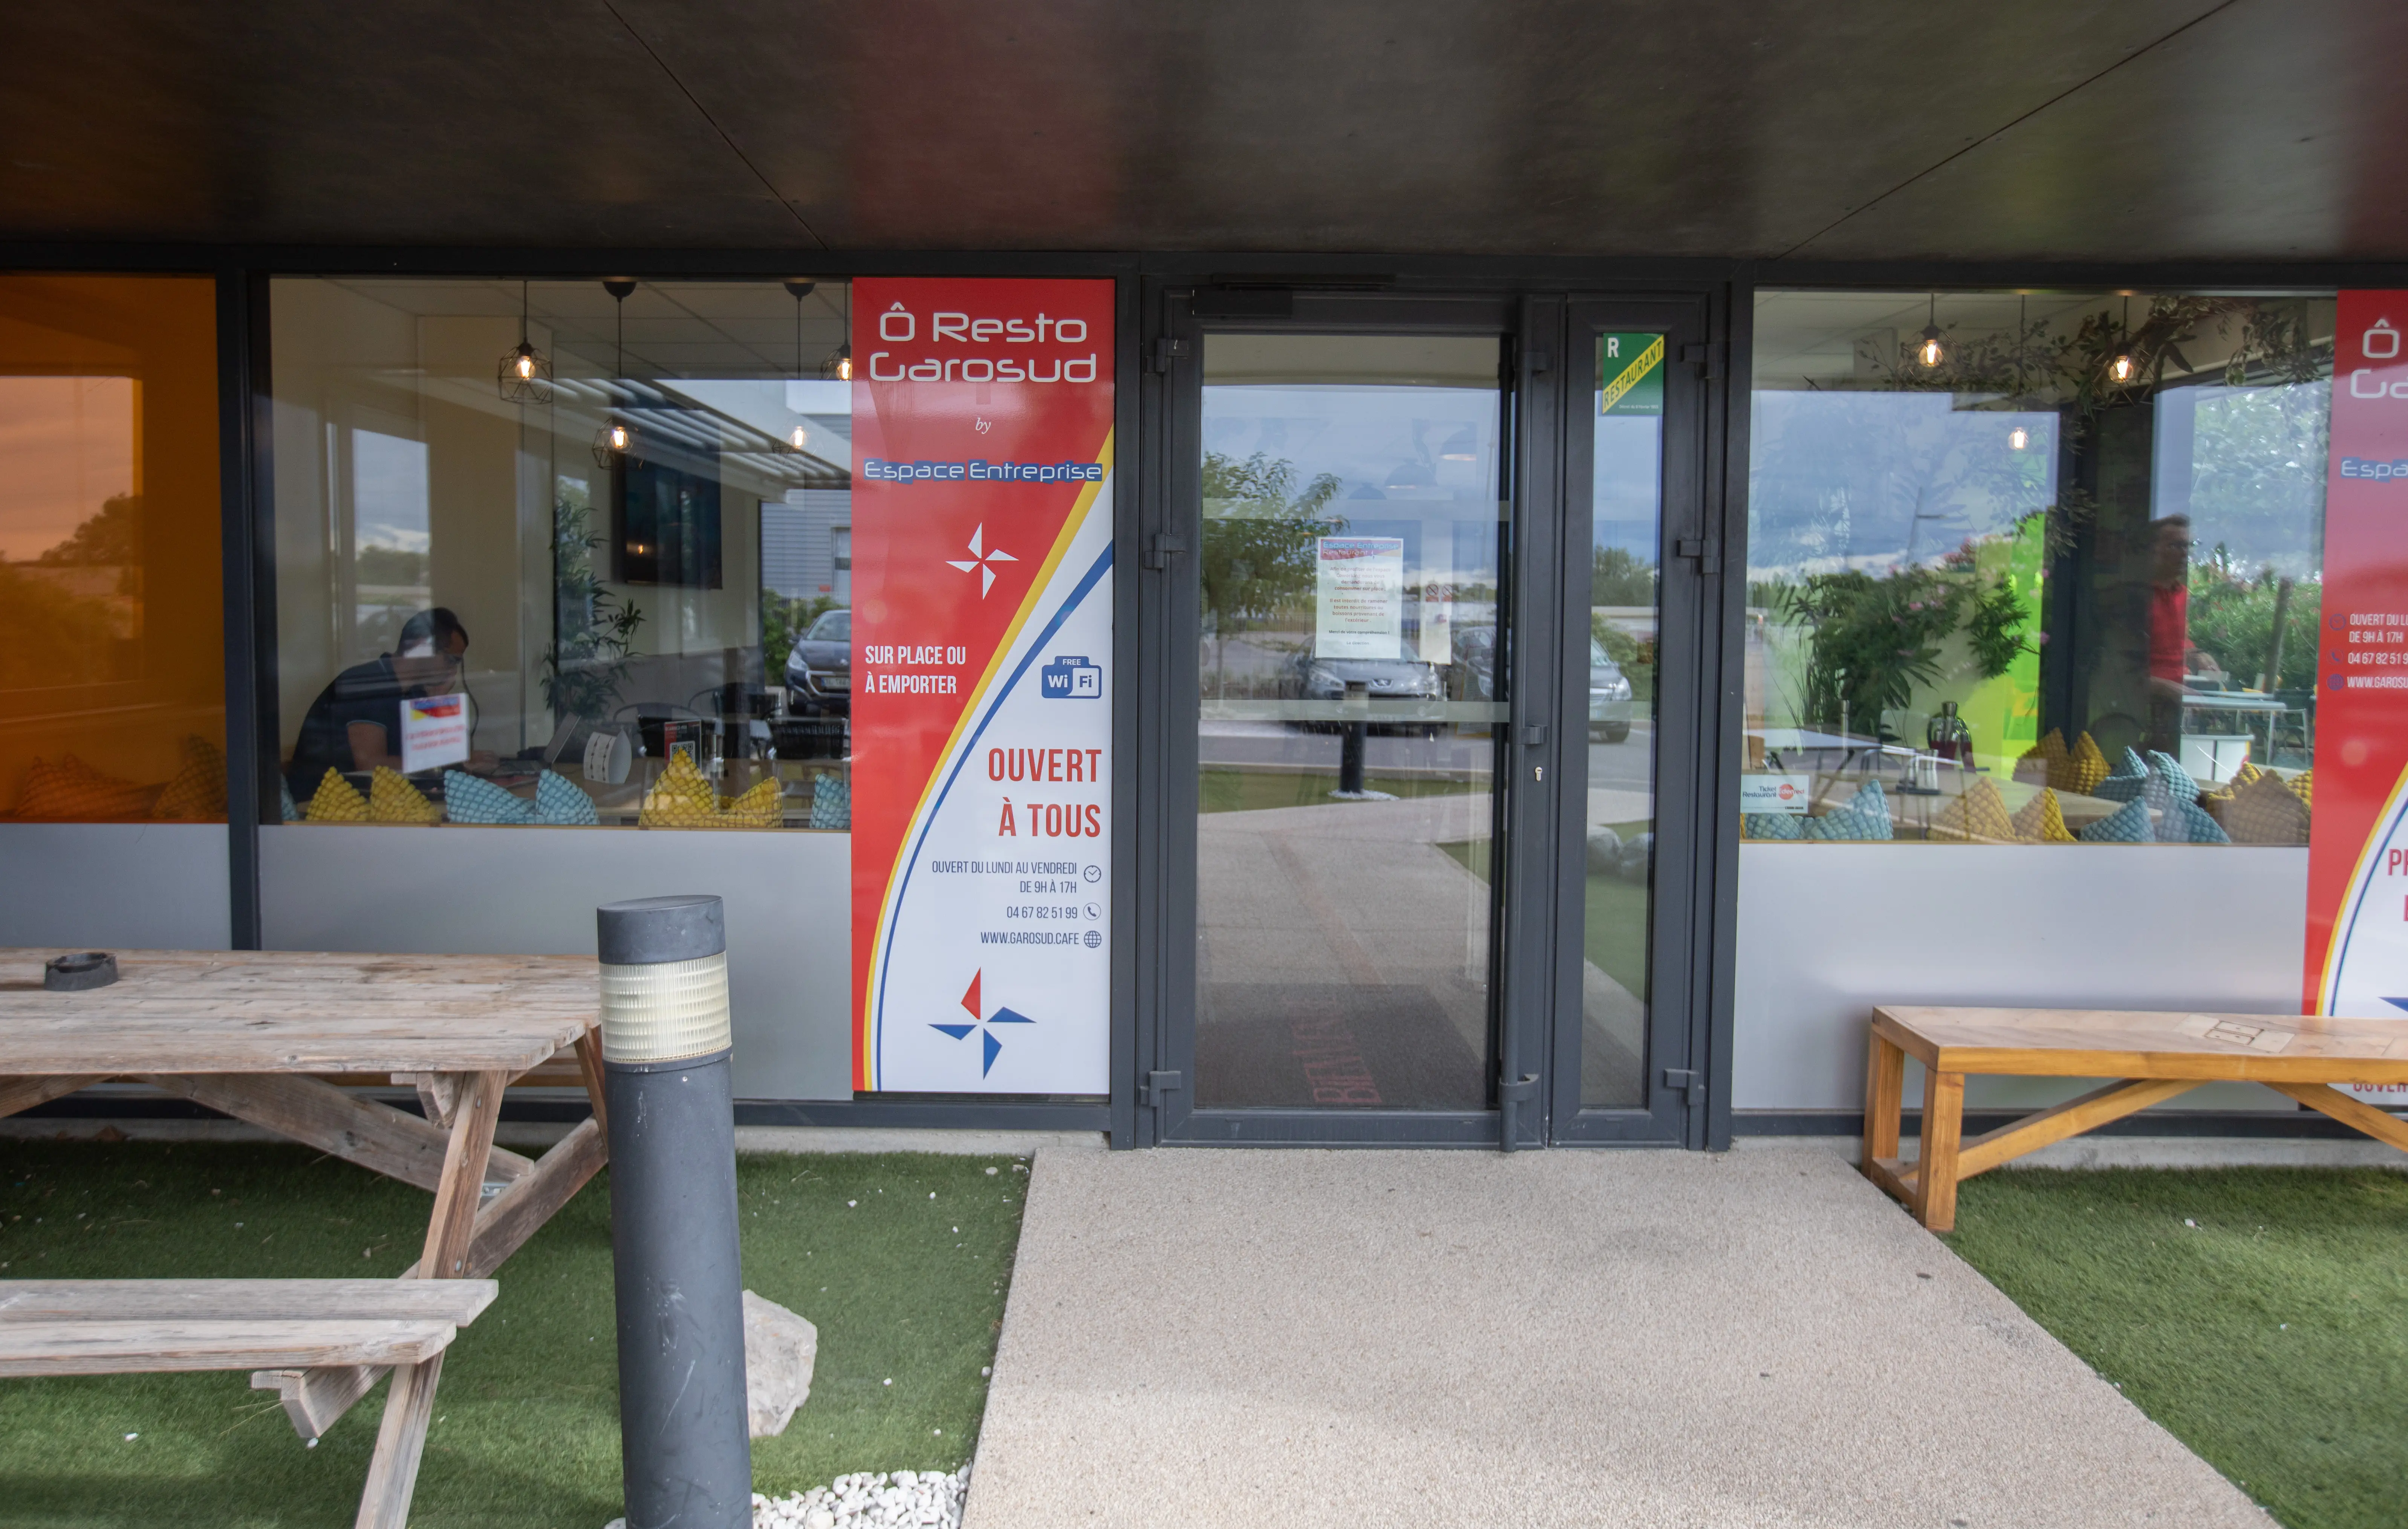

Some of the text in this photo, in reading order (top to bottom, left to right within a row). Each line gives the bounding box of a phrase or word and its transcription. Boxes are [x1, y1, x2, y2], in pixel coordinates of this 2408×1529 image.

[880, 302, 1087, 342] Ô Resto
[1608, 338, 1619, 358] R
[2362, 319, 2400, 358] Ô
[870, 352, 1097, 382] Garosud
[1603, 341, 1662, 408] RESTAURANT
[975, 417, 991, 434] by
[865, 462, 1101, 482] Espace Entreprise
[2350, 613, 2385, 625] OUVERT
[2386, 614, 2398, 625] DU
[2349, 630, 2403, 643] DE 9H À 17H
[866, 645, 965, 665] SUR PLACE OU
[2348, 653, 2360, 664] 04
[2362, 653, 2374, 664] 67
[2376, 653, 2388, 664] 82
[2389, 653, 2401, 664] 51
[865, 671, 875, 693] À
[879, 675, 957, 694] EMPORTER
[988, 748, 1102, 782] OUVERT
[998, 797, 1101, 837] À TOUS
[932, 861, 1077, 875] OUVERT DU LUNDI AU VENDREDI
[1020, 879, 1077, 893] DE 9H À 17H
[1007, 906, 1077, 919] 04 67 82 51 99
[981, 932, 1079, 945] WWW.GAROSUD.CAFE
